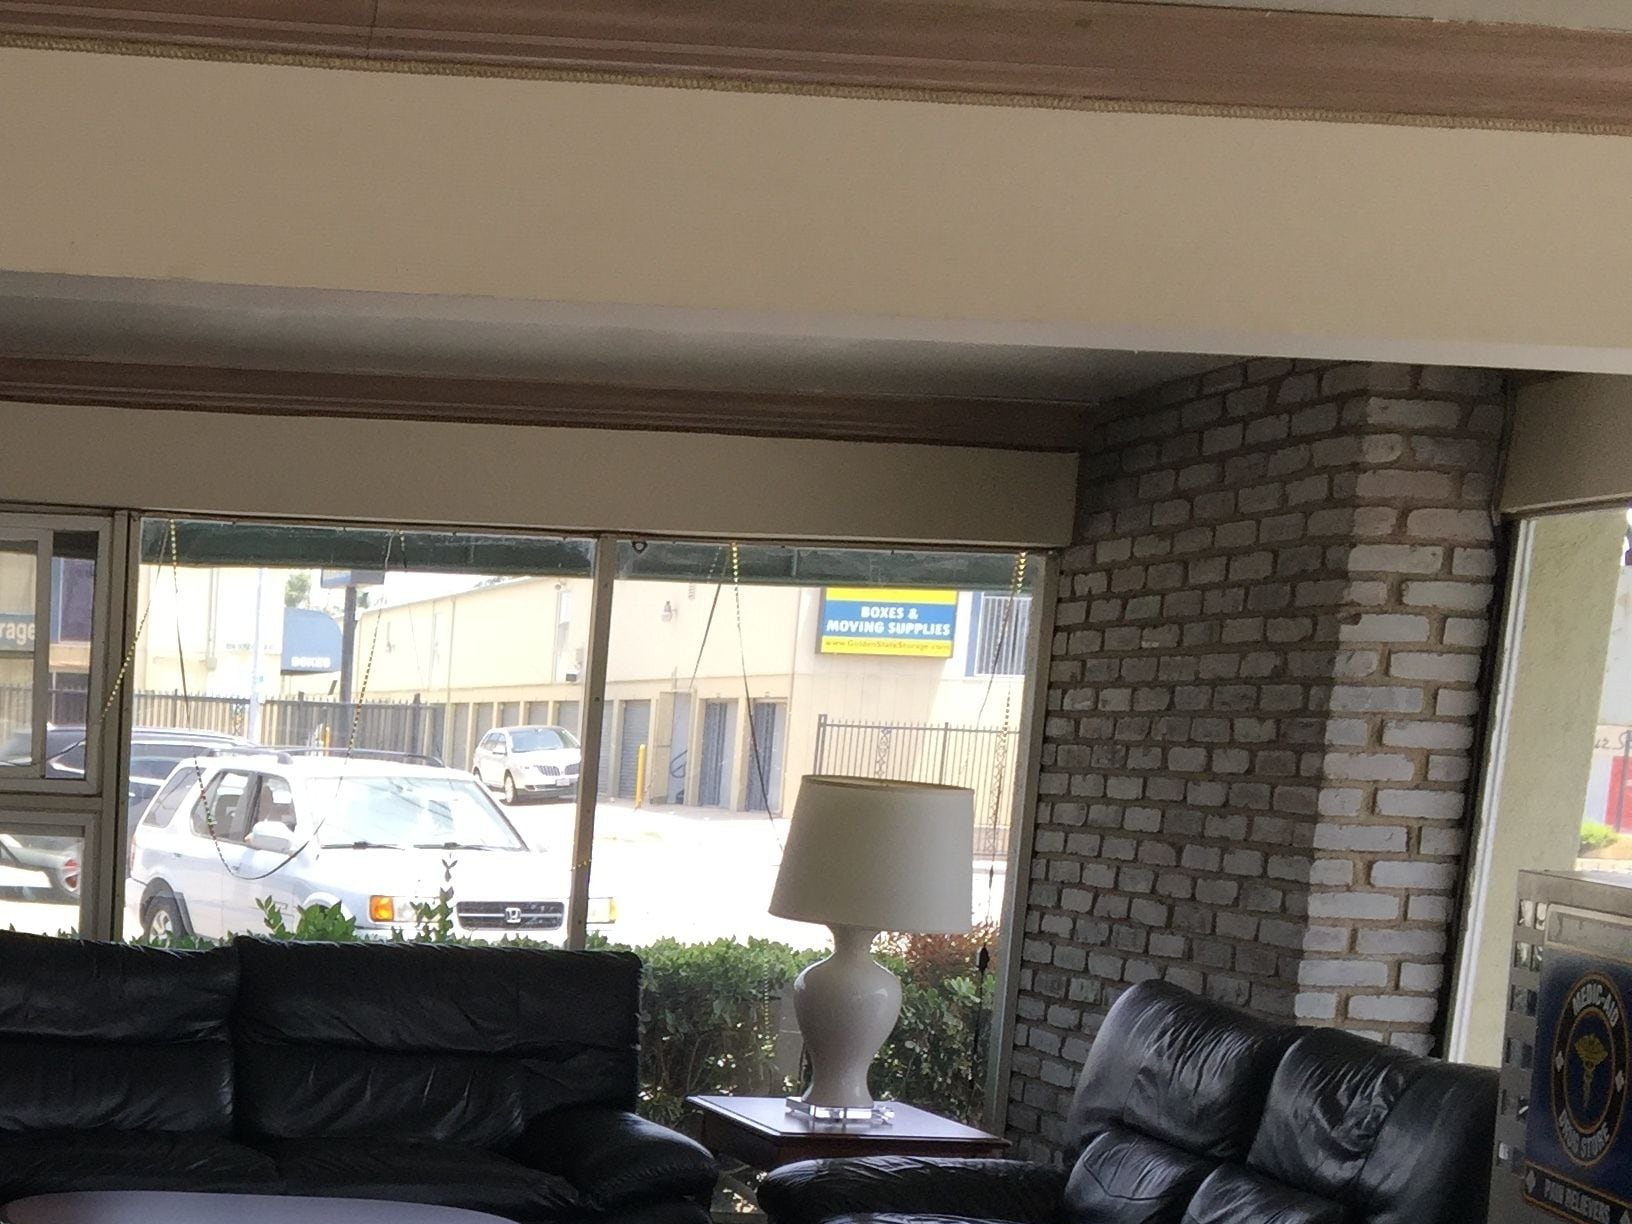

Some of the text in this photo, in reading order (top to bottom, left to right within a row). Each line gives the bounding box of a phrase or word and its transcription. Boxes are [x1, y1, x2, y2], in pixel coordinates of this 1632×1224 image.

[861, 606, 919, 620] BOXES &
[826, 619, 951, 636] MOVING SUPPLIES
